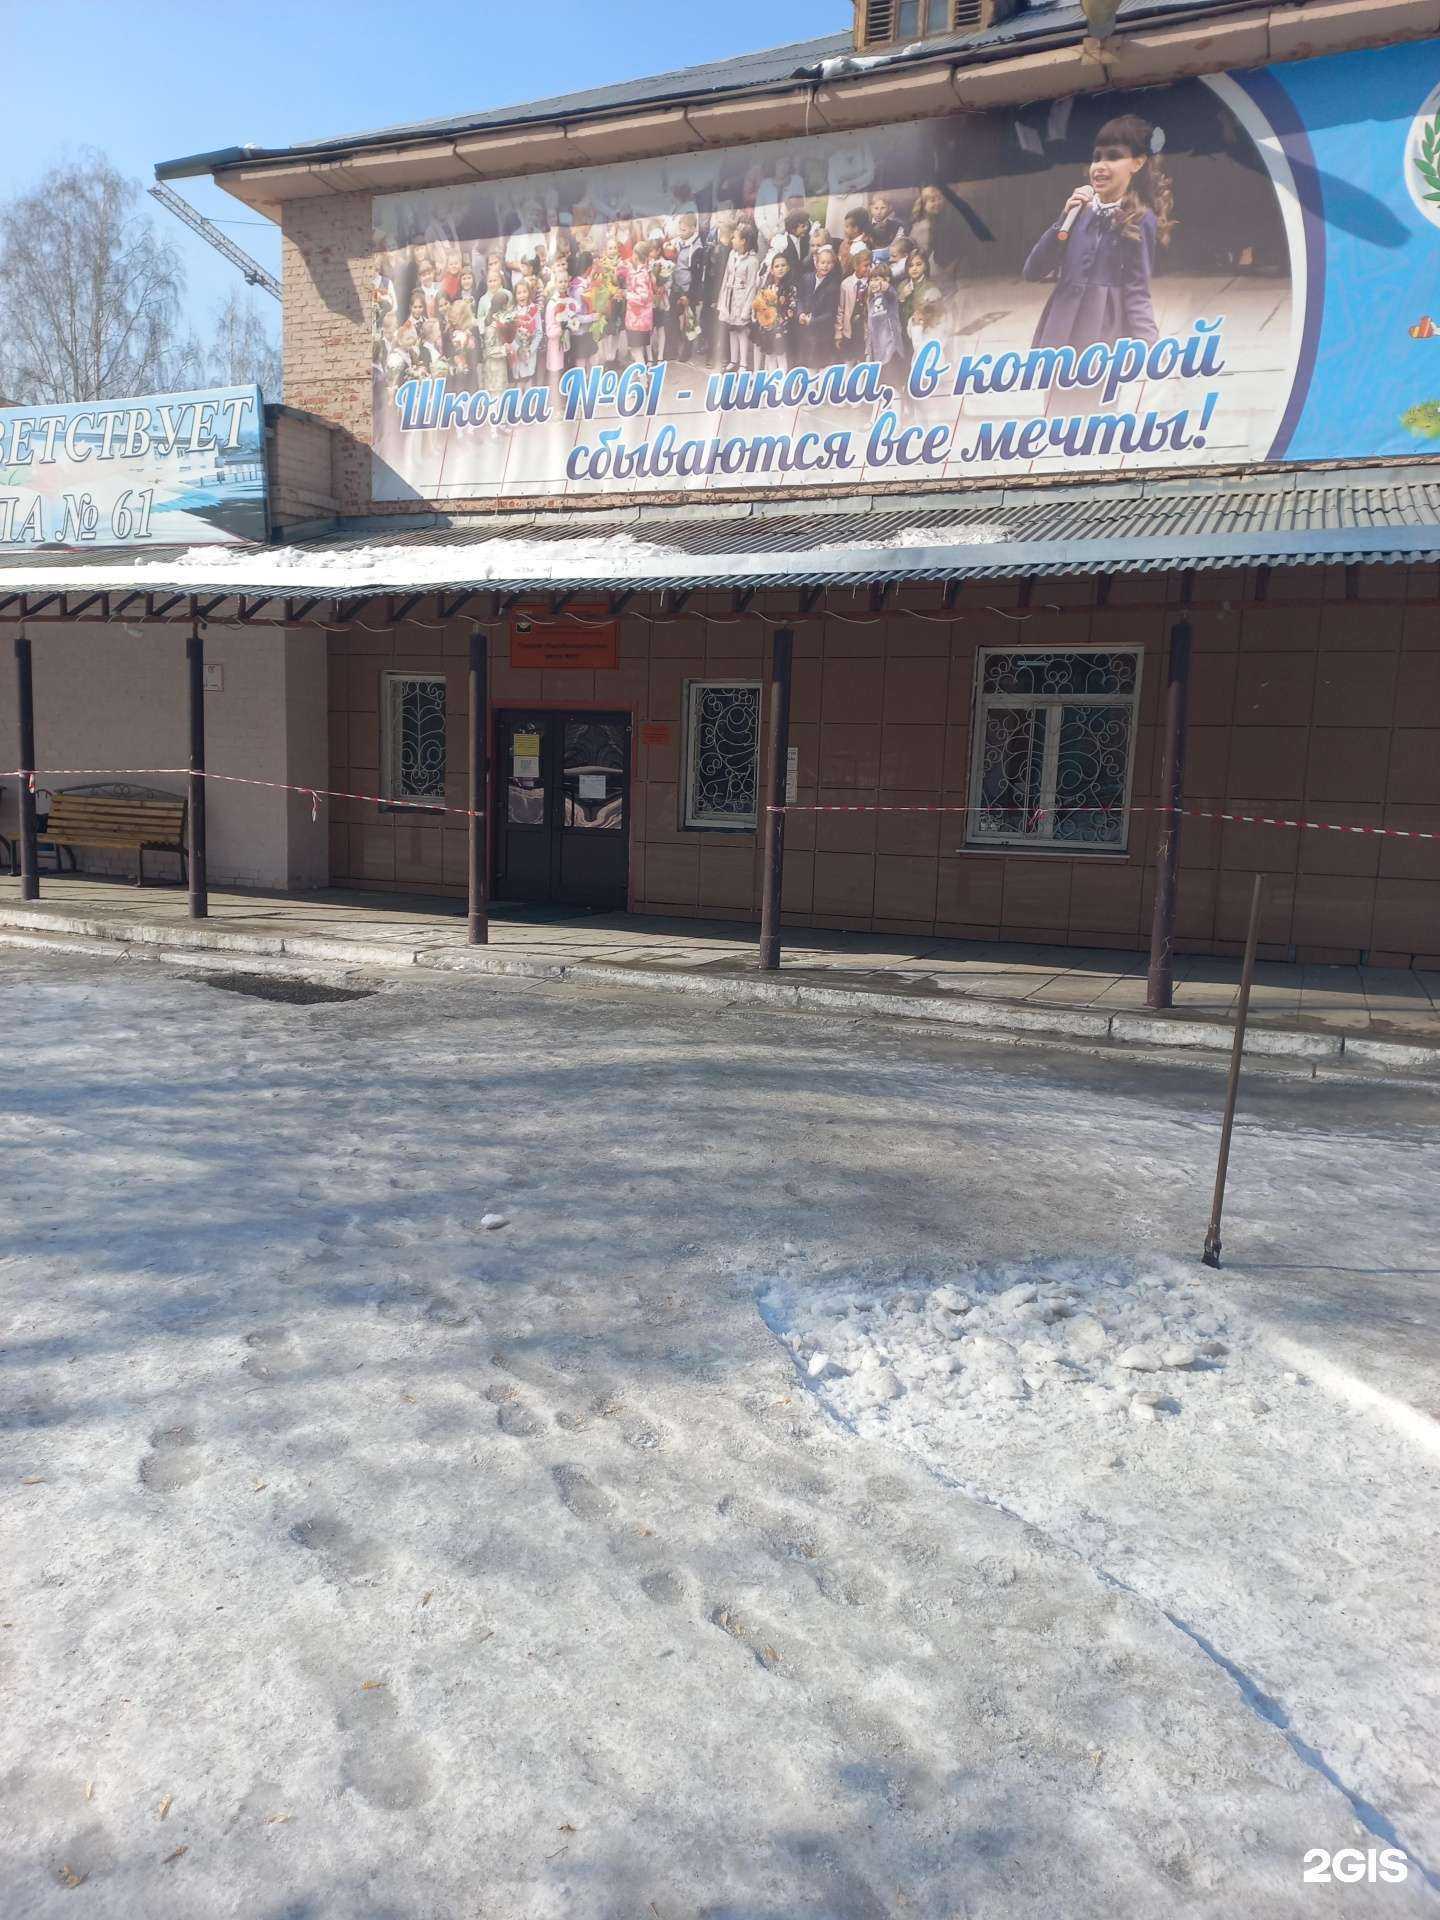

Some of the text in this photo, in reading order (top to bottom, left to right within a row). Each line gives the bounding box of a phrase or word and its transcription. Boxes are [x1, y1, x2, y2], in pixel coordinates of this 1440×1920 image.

[396, 377, 551, 431] Школа
[561, 361, 667, 421] №61
[705, 362, 894, 412] школа,
[908, 339, 950, 399] в
[953, 316, 1226, 404] которой
[0, 396, 254, 467] ЕТСТВУЕТ
[566, 392, 1220, 481] сбываются все мечты!
[55, 492, 99, 542] №
[112, 488, 153, 540] 61
